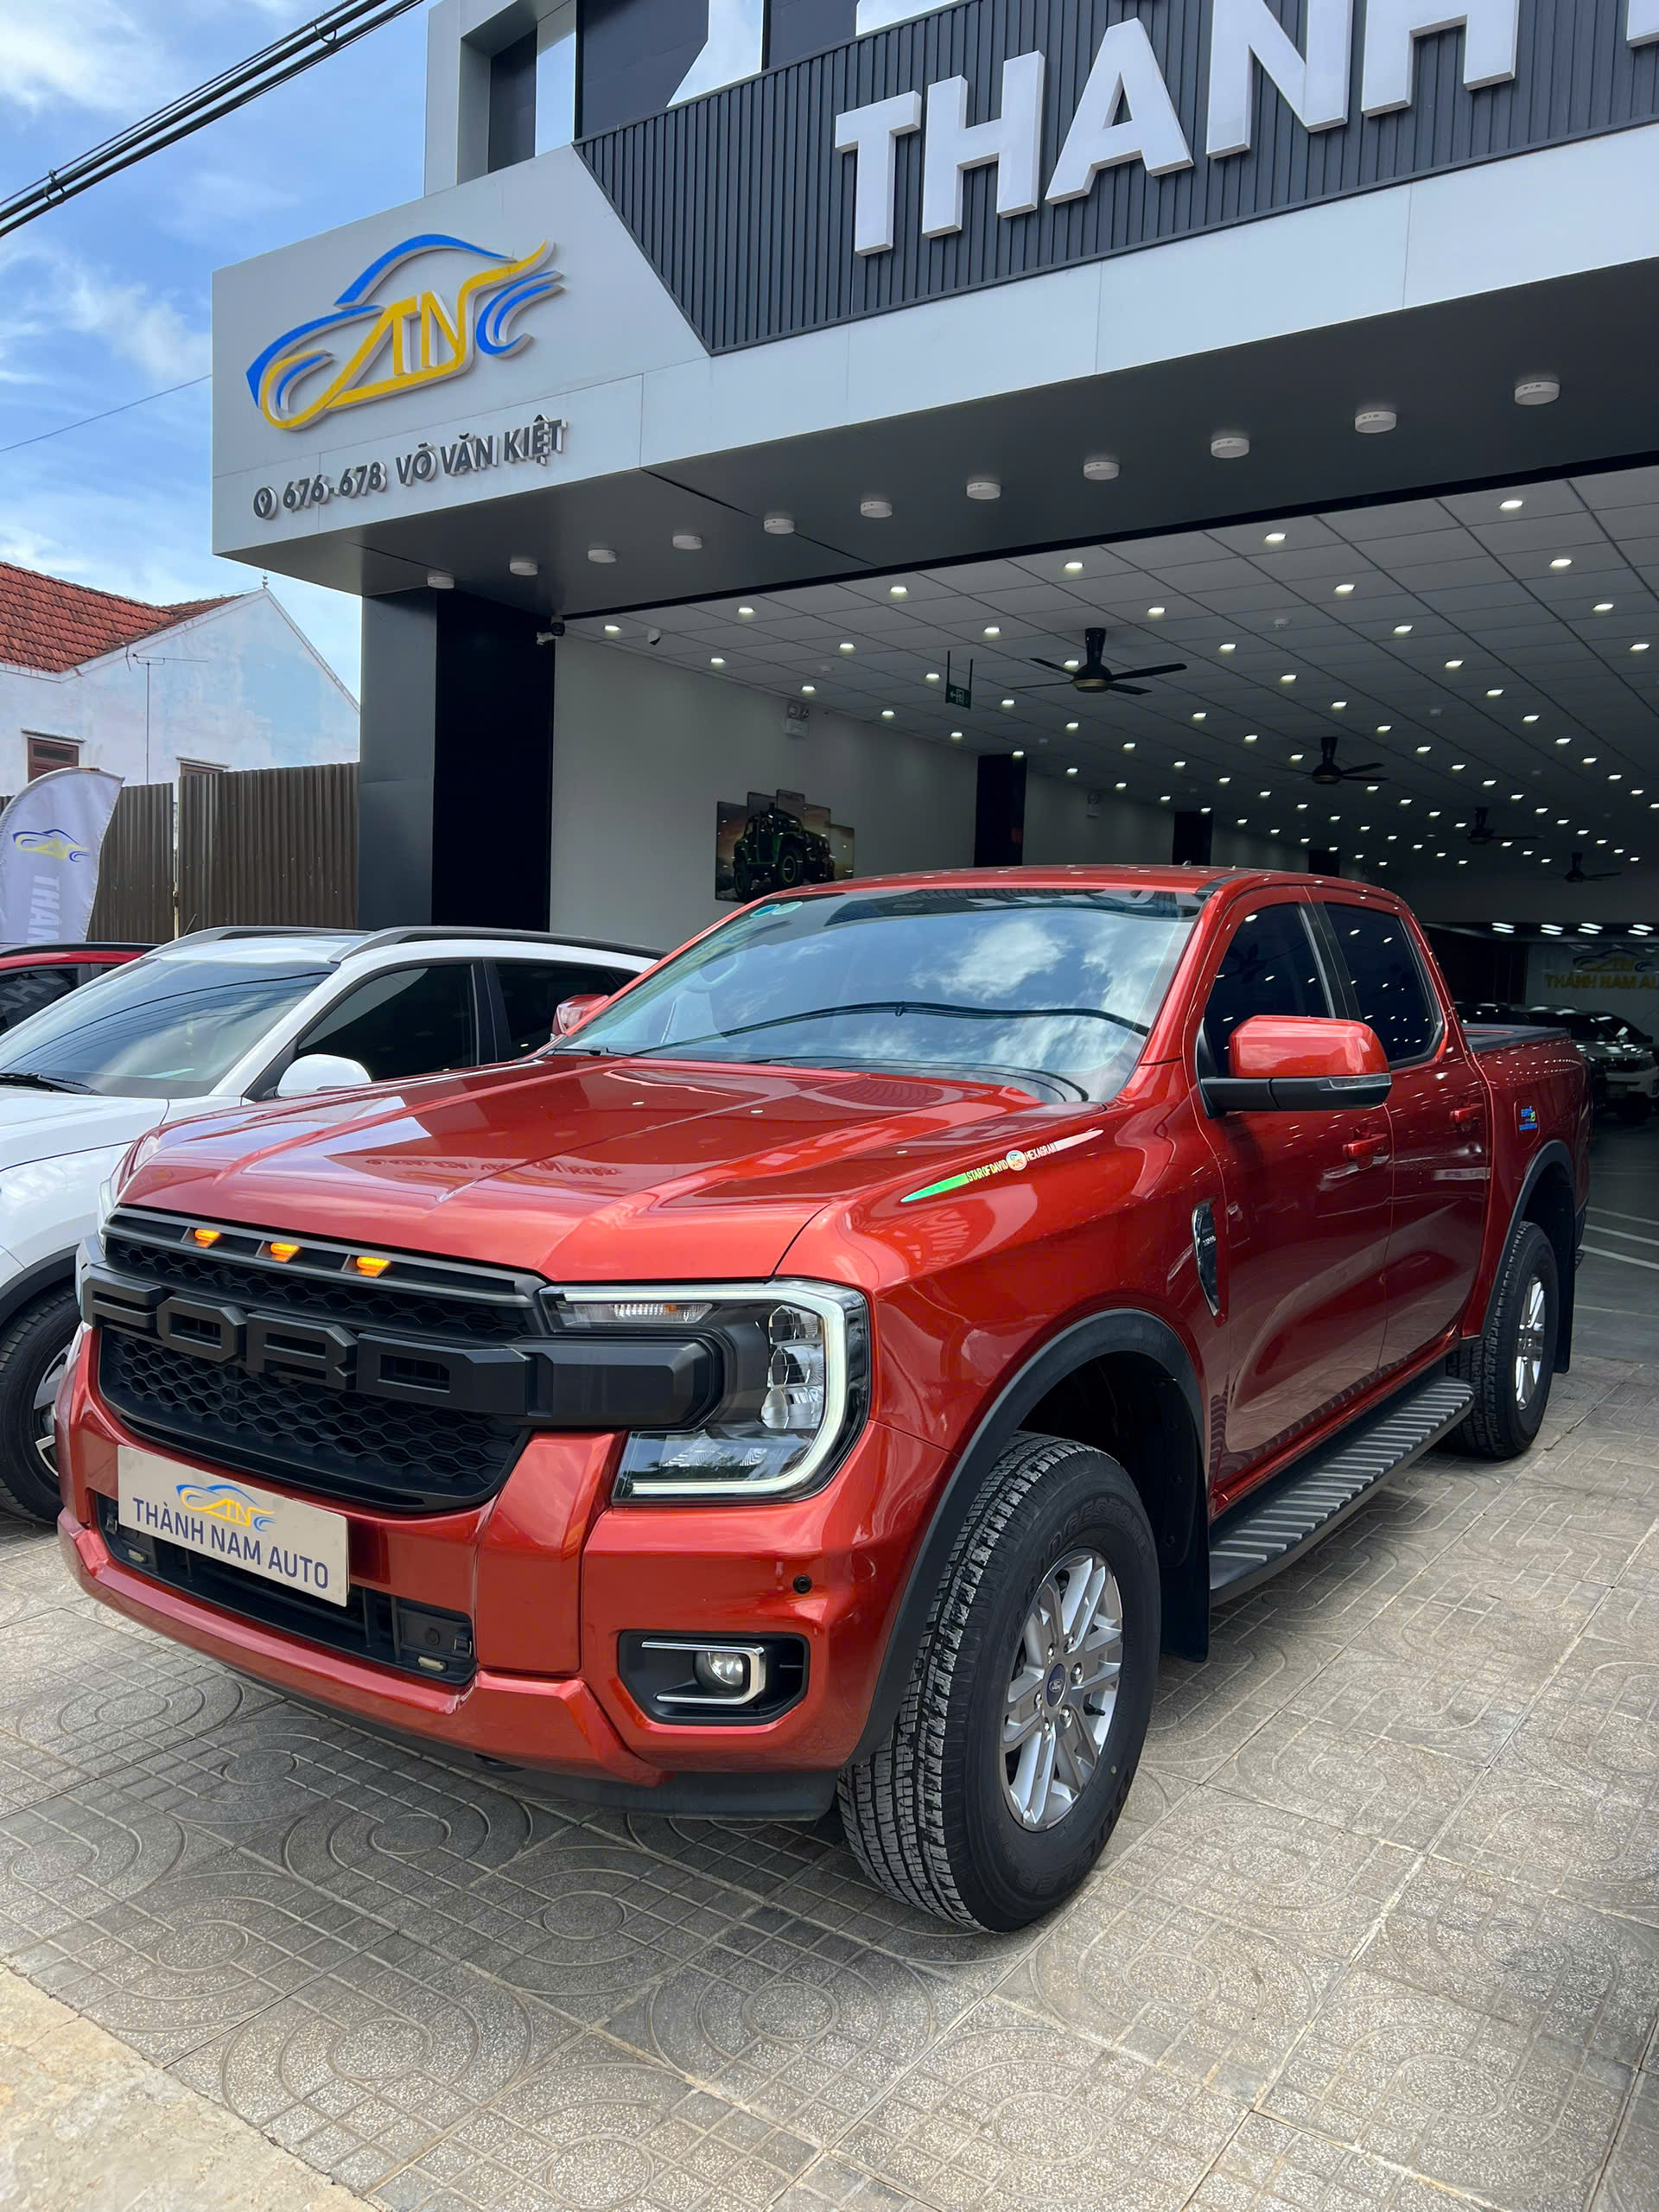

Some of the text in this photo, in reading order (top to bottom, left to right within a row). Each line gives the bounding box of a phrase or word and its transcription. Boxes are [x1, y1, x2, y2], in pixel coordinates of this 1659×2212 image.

[283, 414, 568, 512] 676-678 VÕ VĂN KIỆT
[83, 1264, 529, 1418] FORD
[132, 1497, 328, 1589] THÀNH NAM AUTO
